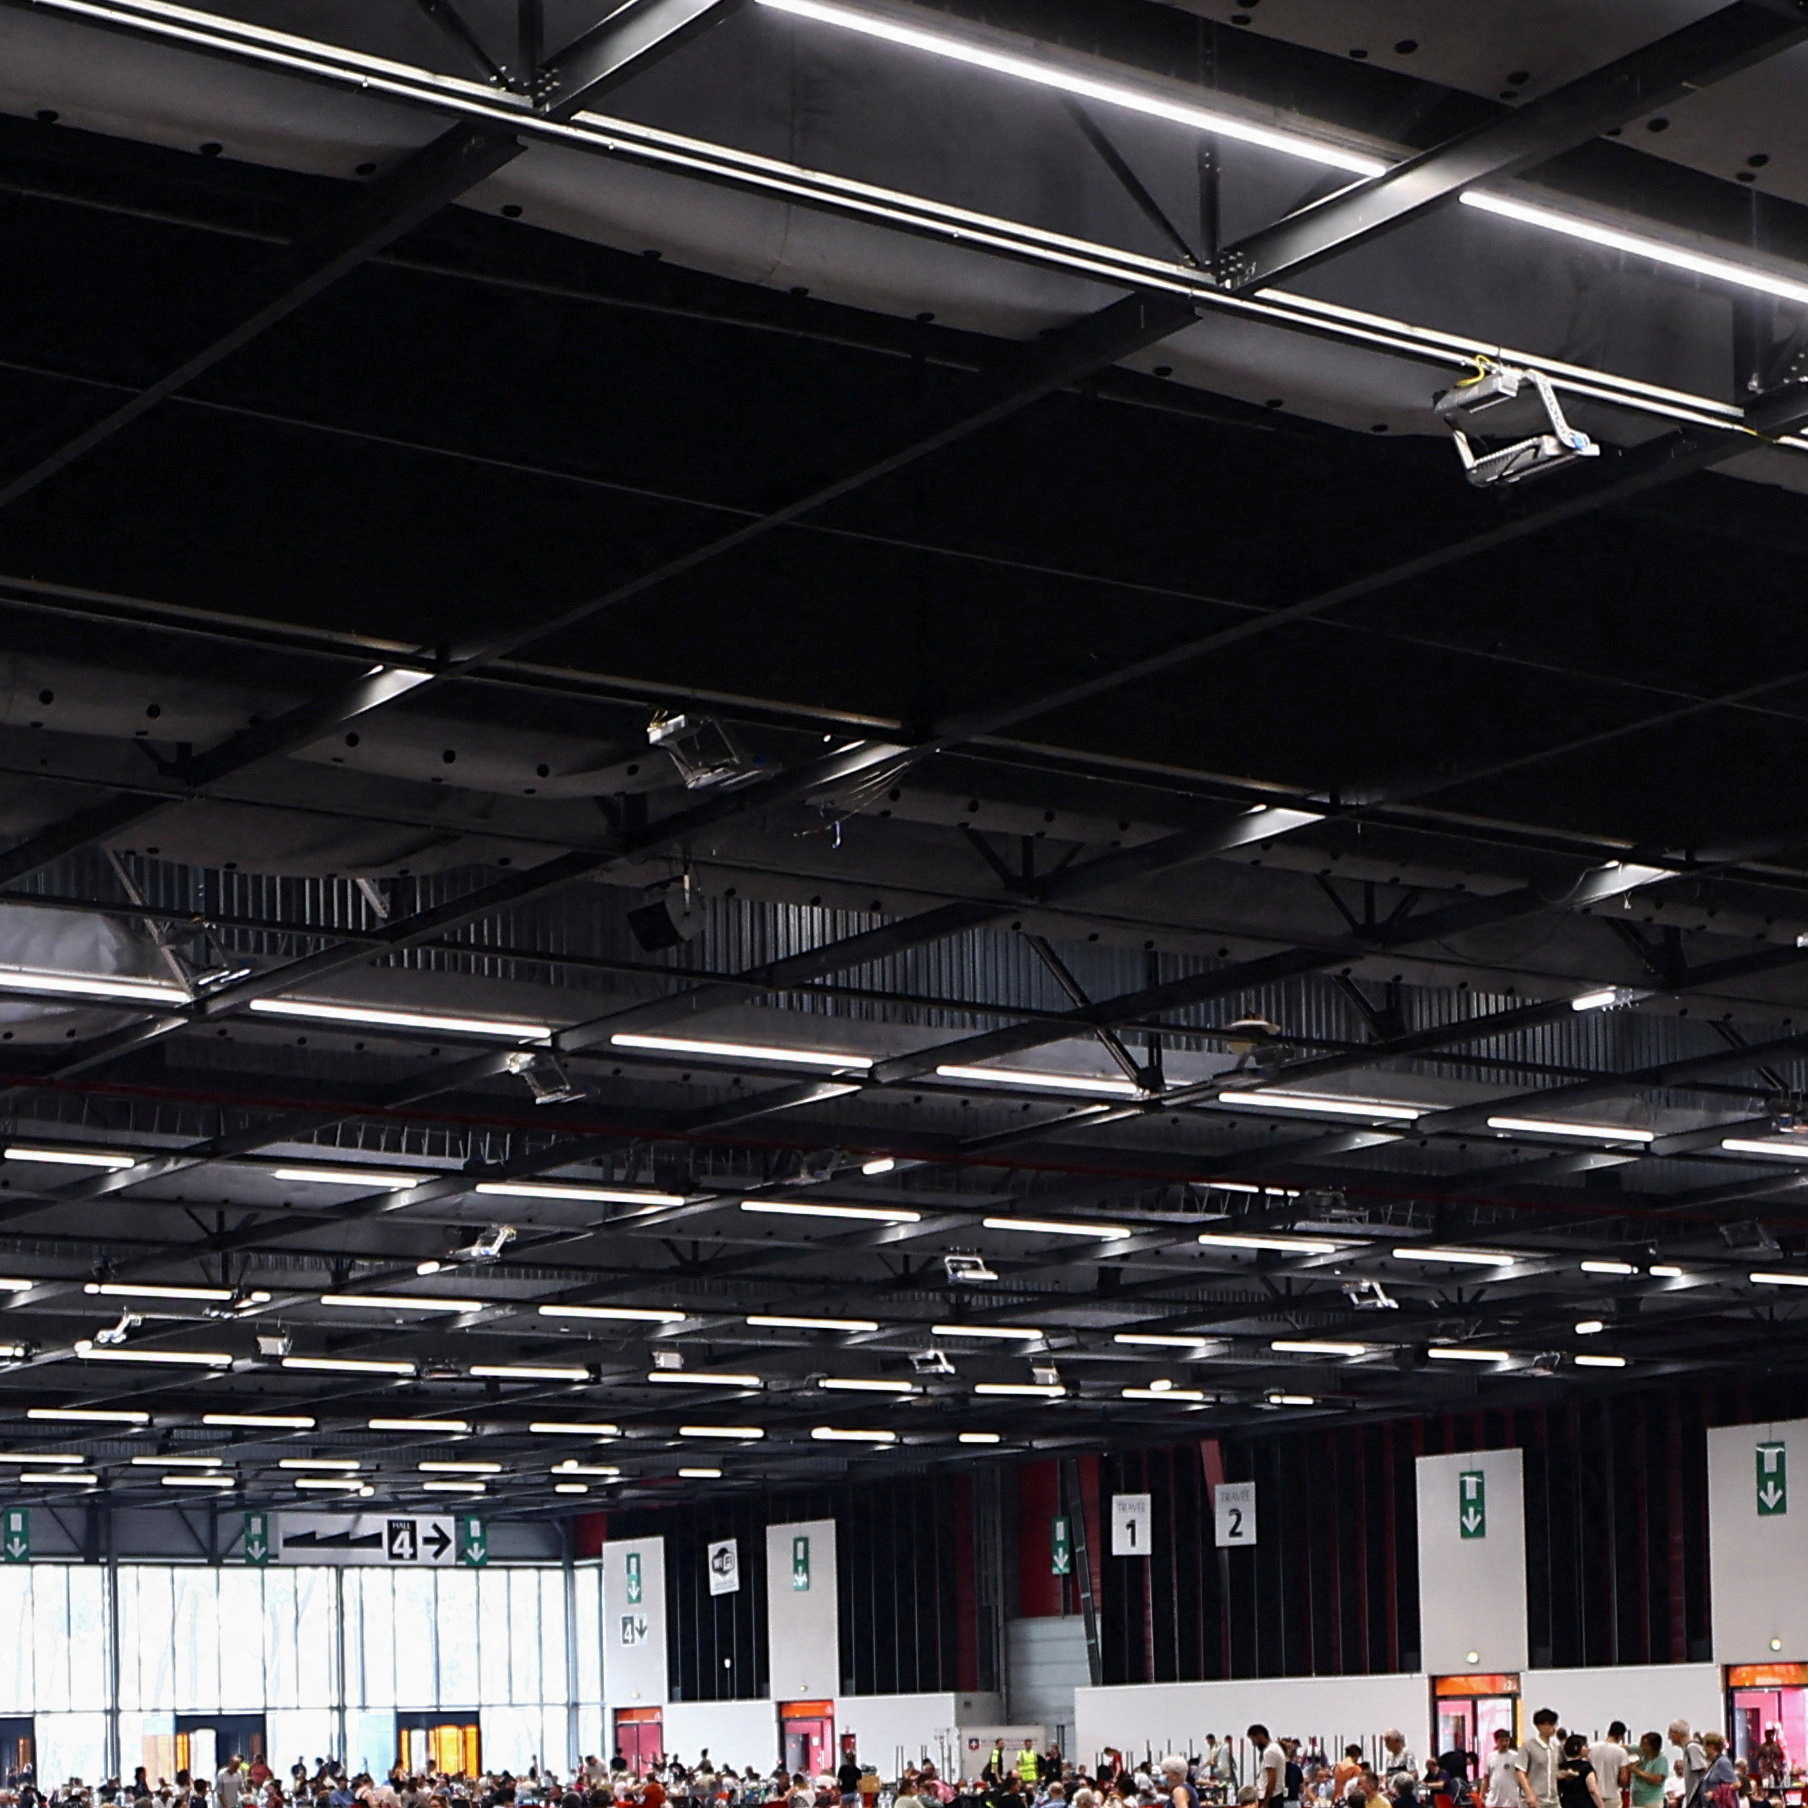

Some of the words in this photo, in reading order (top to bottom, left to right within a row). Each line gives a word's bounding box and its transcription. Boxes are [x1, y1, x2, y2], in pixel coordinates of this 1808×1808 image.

[392, 1521, 411, 1529] HALL
[1126, 1519, 1136, 1548] 1
[1228, 1508, 1243, 1538] 2
[392, 1530, 413, 1559] 4
[624, 1623, 633, 1643] 4
